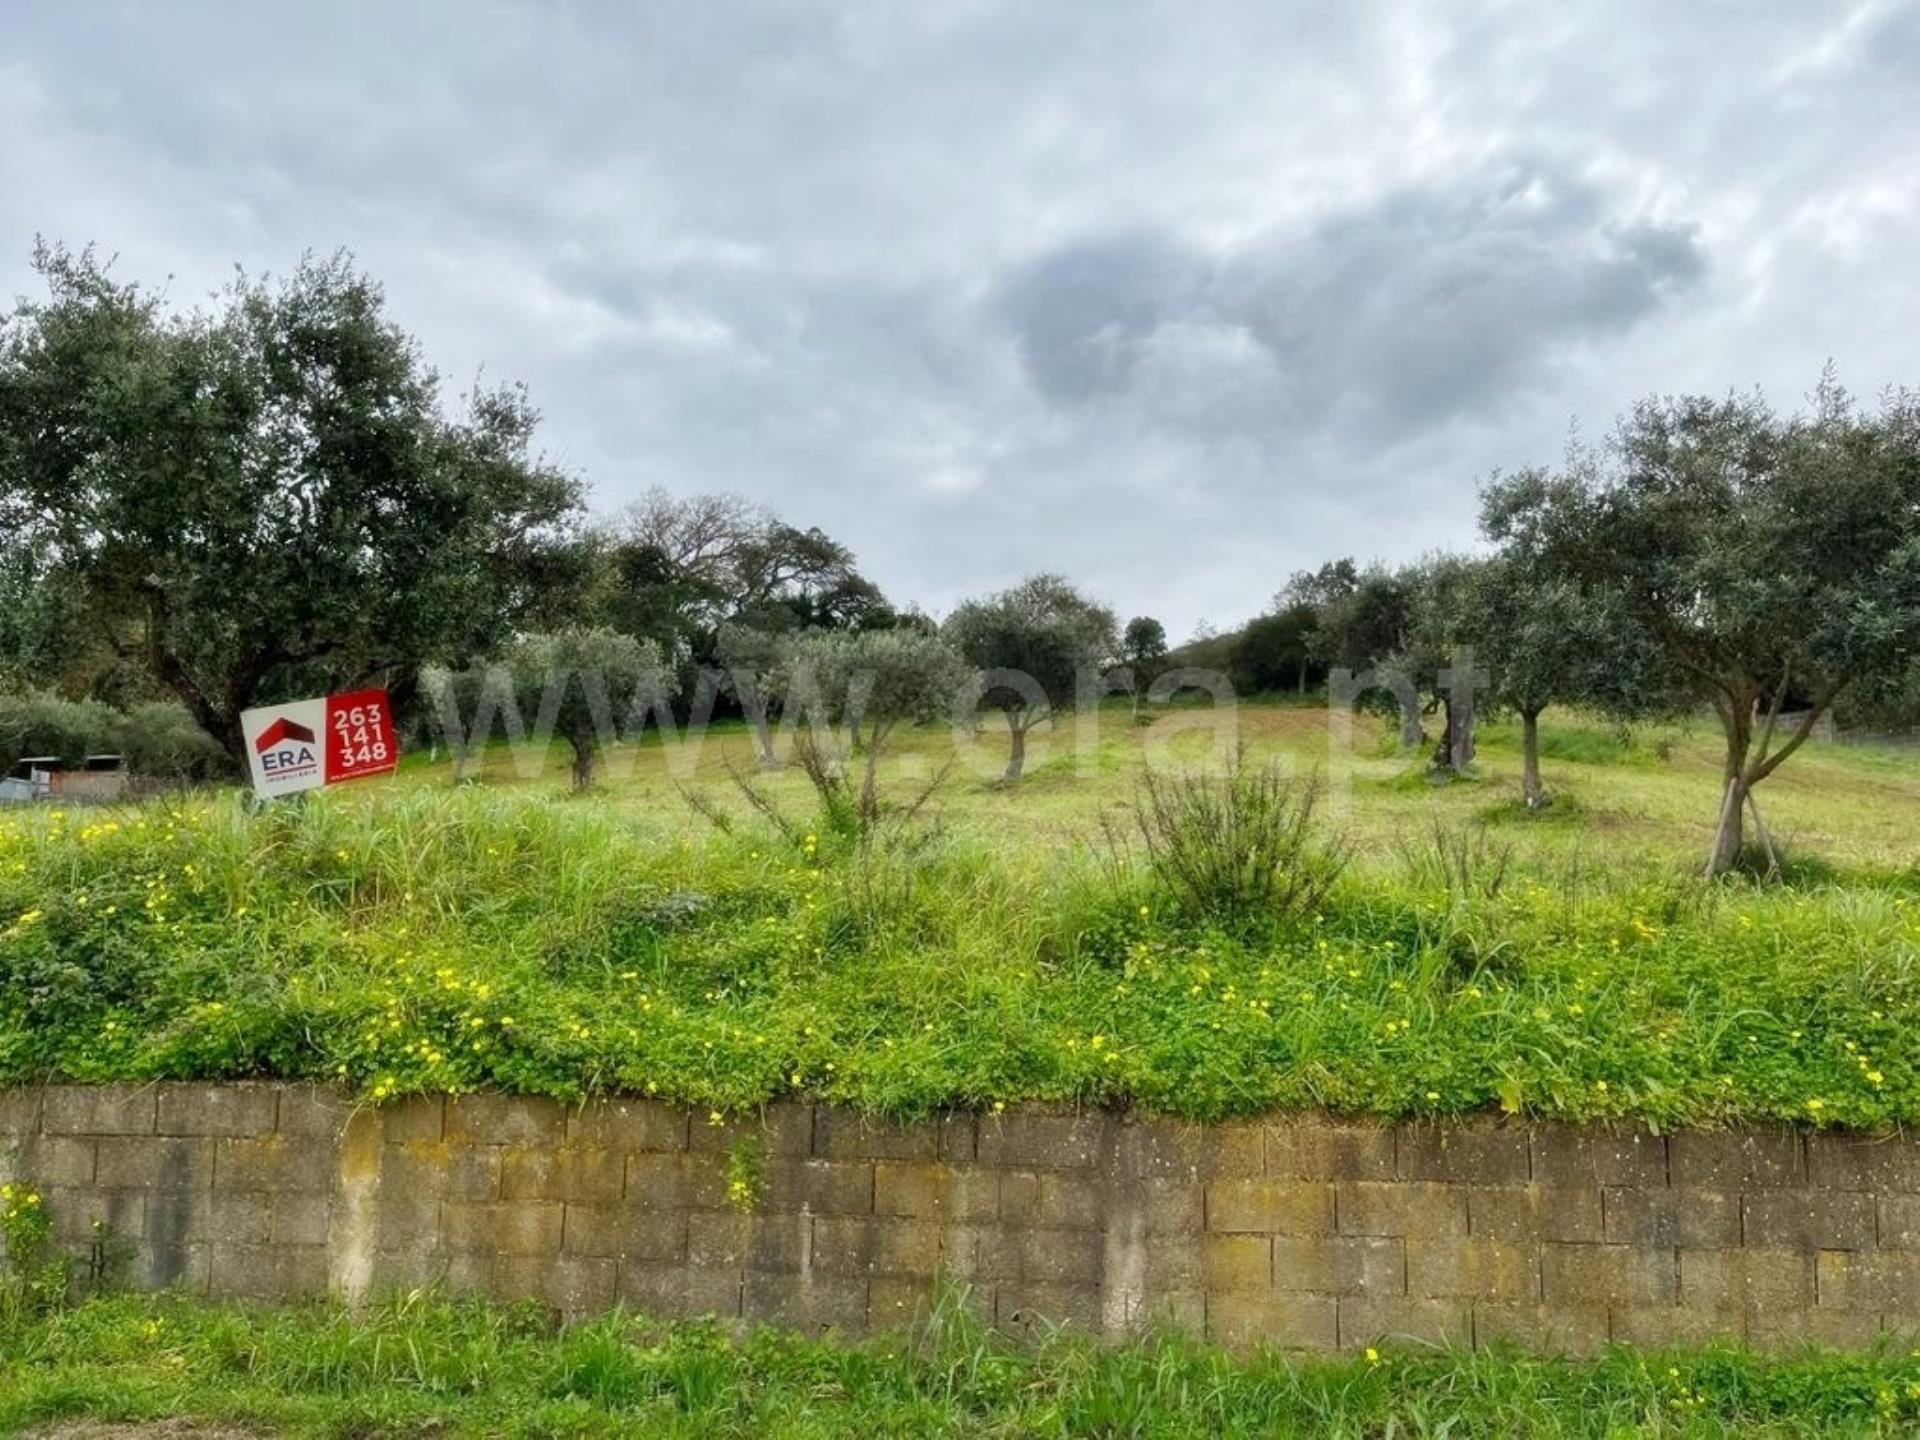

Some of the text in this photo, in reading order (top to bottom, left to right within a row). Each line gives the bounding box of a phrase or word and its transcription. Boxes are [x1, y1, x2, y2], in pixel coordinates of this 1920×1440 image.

[333, 704, 382, 730] 263
[339, 723, 382, 748] 141
[261, 747, 315, 771] ERA
[341, 742, 387, 767] 348
